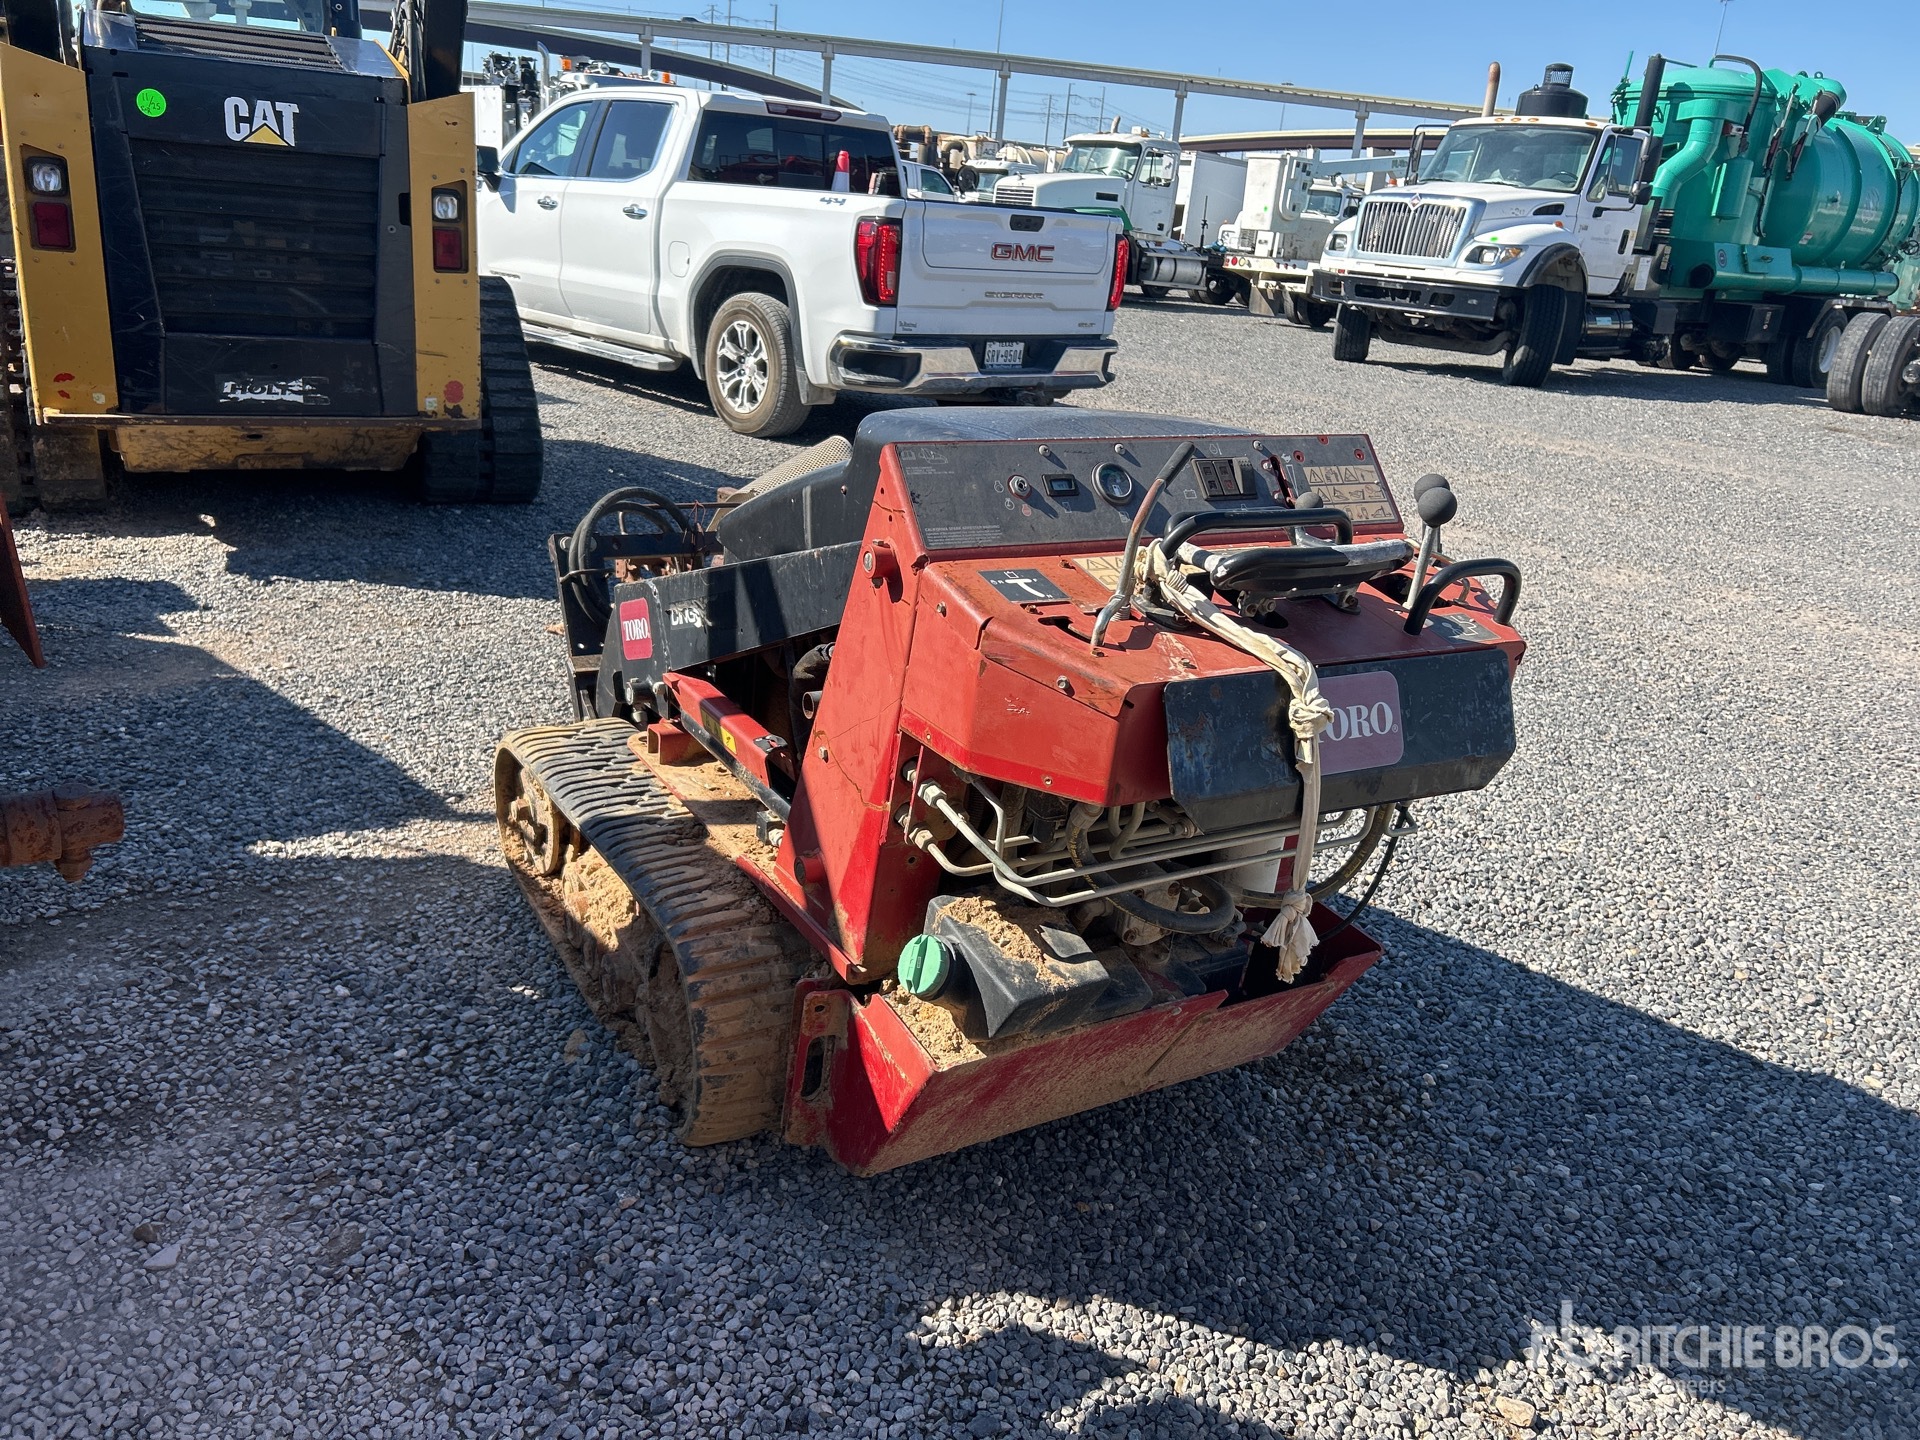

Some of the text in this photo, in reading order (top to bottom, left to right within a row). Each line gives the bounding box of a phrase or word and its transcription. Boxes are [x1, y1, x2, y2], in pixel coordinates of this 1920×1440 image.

[224, 96, 299, 147] CAT
[991, 242, 1055, 262] GMC
[985, 291, 1044, 299] SIERRA
[623, 617, 649, 641] TORO
[1319, 702, 1393, 743] ORO
